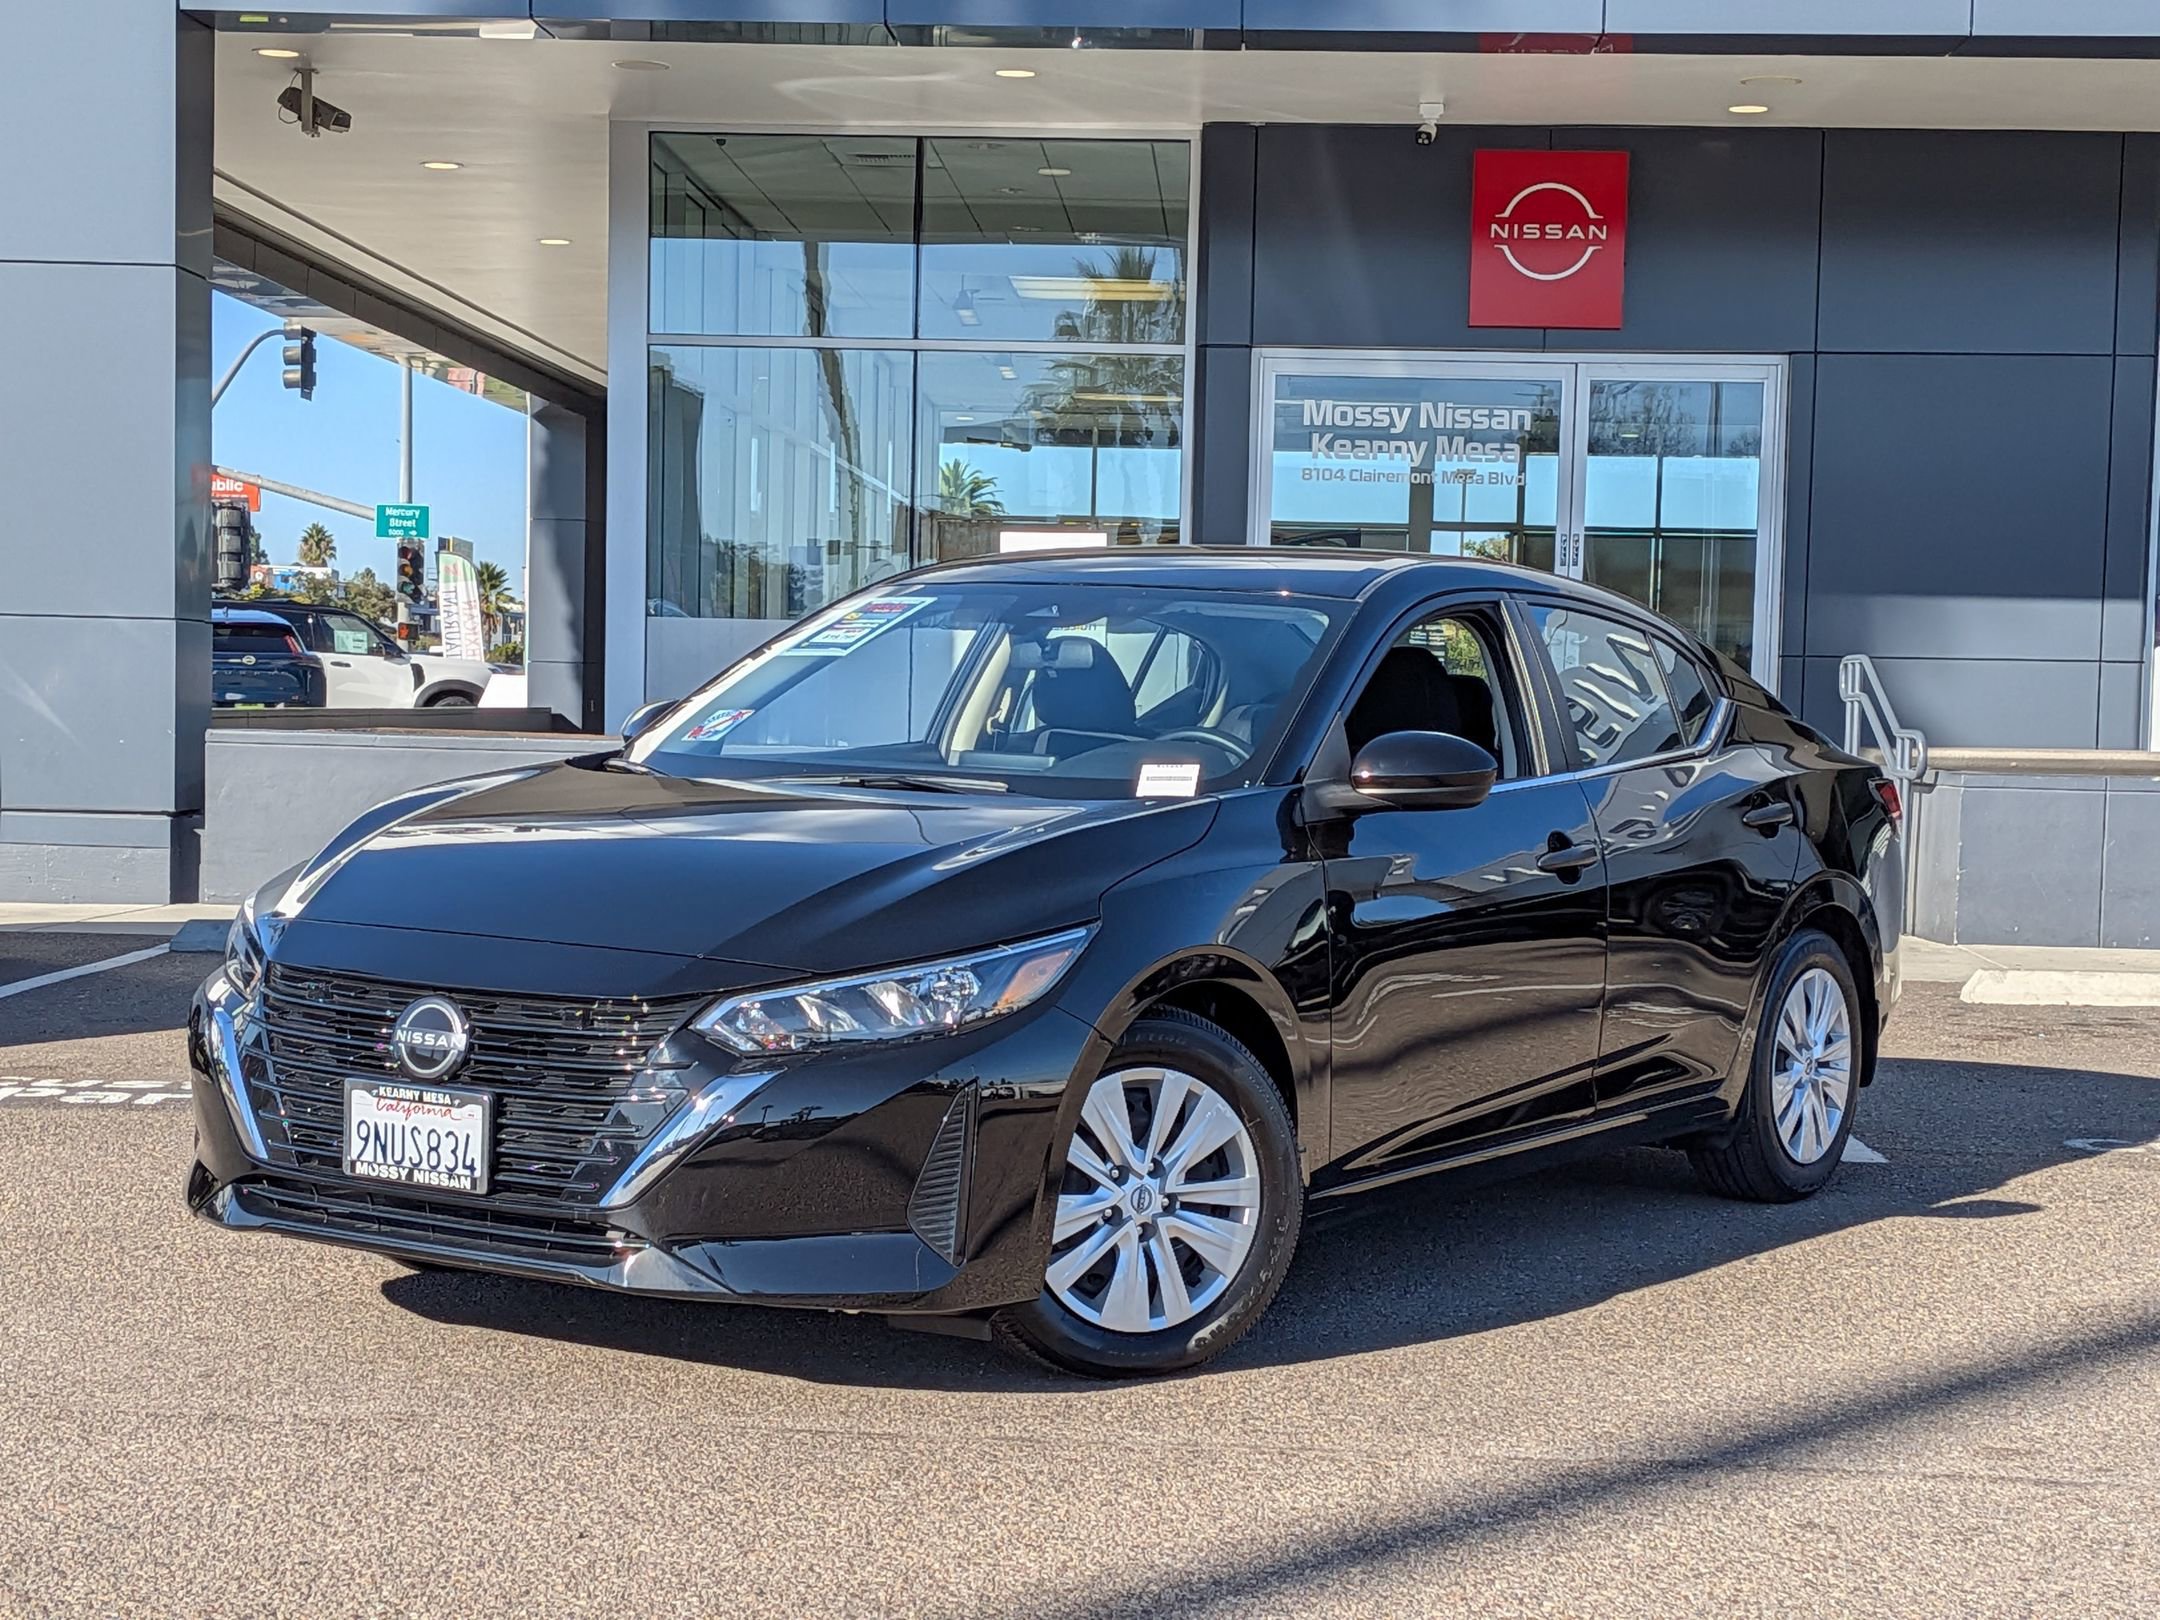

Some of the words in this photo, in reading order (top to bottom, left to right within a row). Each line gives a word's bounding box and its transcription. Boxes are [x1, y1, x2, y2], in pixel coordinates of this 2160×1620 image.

[1490, 223, 1607, 240] NISSAN
[1303, 399, 1411, 433] Mossy
[1419, 402, 1531, 431] Nissan
[1311, 432, 1428, 466] Kearny
[1436, 435, 1521, 463] Mesa
[1301, 467, 1345, 482] 8104
[1349, 468, 1437, 484] Clairemont
[1441, 470, 1484, 485] Mesa
[1488, 471, 1525, 486] Blvd
[385, 506, 420, 519] Mercury
[389, 518, 416, 528] Street
[395, 1029, 467, 1051] NISSAN
[378, 1086, 420, 1101] KEARNY
[422, 1091, 452, 1105] MESA
[376, 1097, 462, 1121] California
[355, 1120, 477, 1177] 9NUS834
[355, 1161, 410, 1181] MOSSY
[413, 1169, 472, 1190] NISSAN
